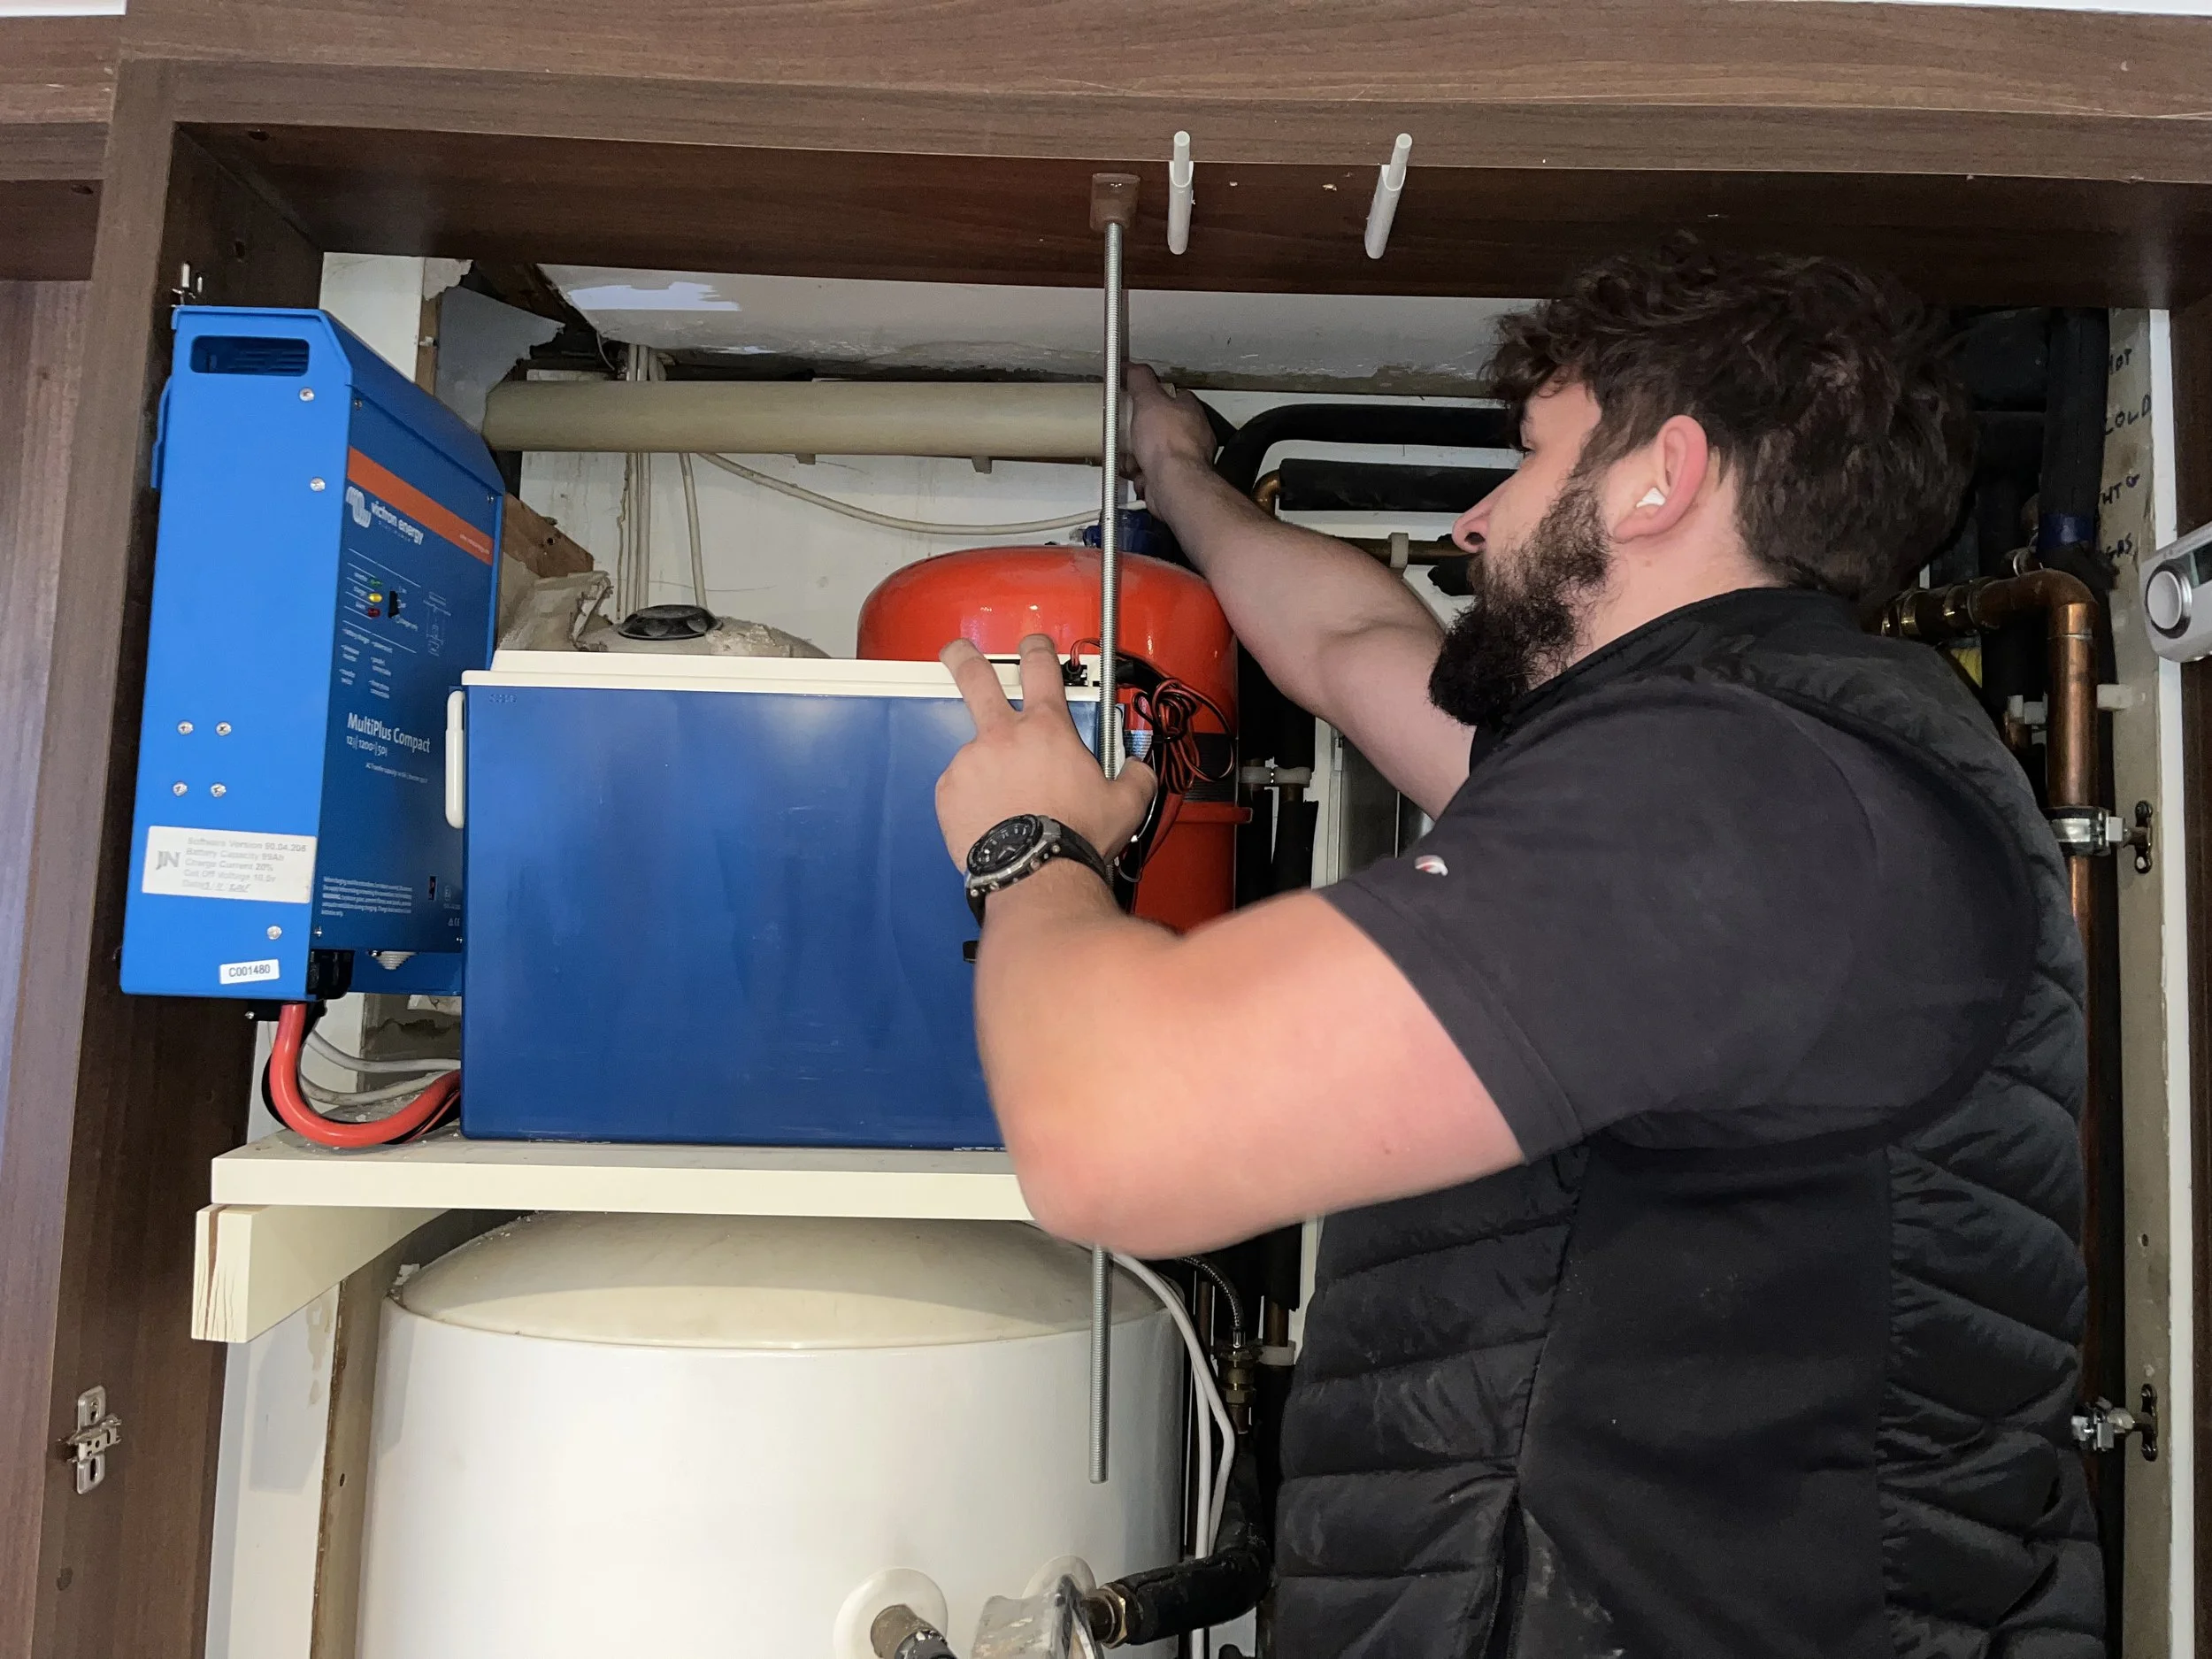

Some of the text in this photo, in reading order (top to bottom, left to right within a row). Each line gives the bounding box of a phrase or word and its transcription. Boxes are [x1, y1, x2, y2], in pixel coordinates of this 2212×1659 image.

[348, 712, 430, 753] MultiPlus Compact
[228, 964, 271, 978] C001480
